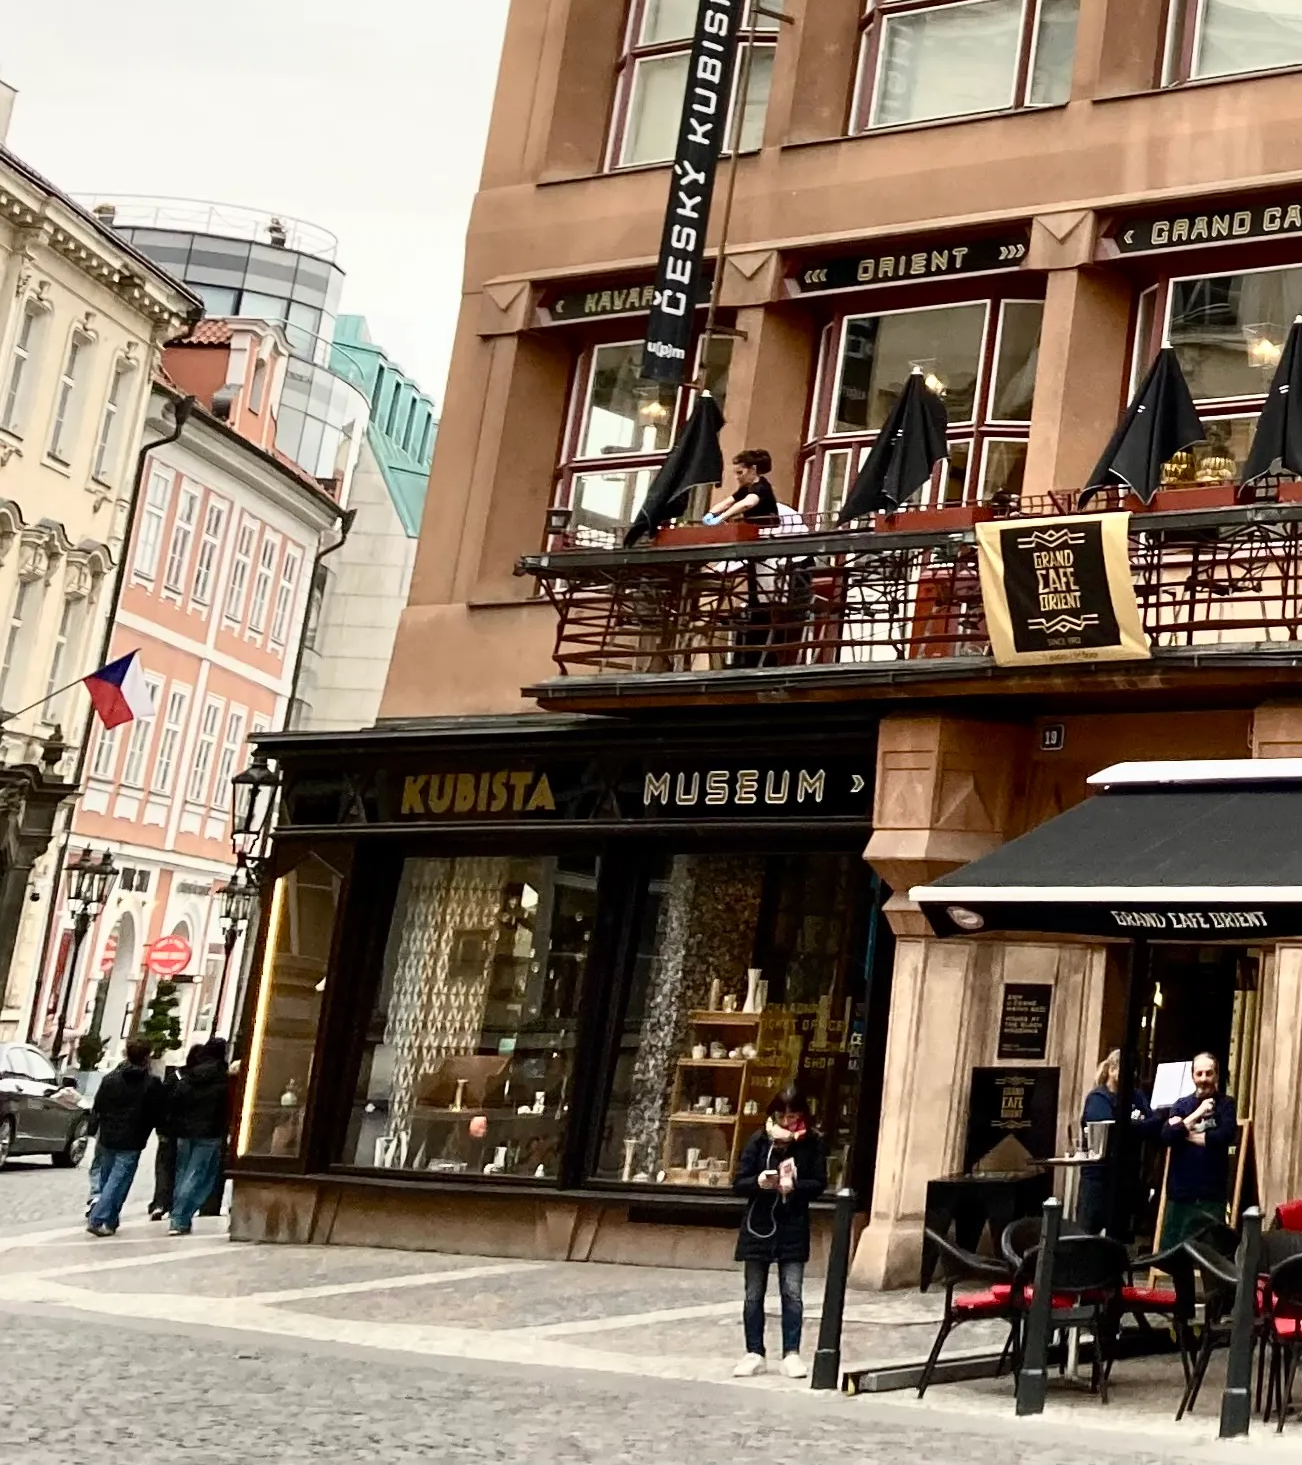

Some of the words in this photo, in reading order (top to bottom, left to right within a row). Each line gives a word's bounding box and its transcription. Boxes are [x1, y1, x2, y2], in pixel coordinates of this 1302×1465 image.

[653, 160, 706, 317] ČESKÝ
[1151, 211, 1251, 245] GRAND
[857, 247, 968, 281] ORIENT
[1033, 549, 1074, 569] GRAND
[1036, 568, 1080, 593] CAFE
[1039, 592, 1082, 611] ORIENT
[401, 769, 556, 814] KUBISTA
[643, 768, 826, 806] MUSEUM
[1110, 910, 1167, 928] GRAND
[1167, 911, 1210, 928] CAFE
[1208, 910, 1268, 928] ORIENT
